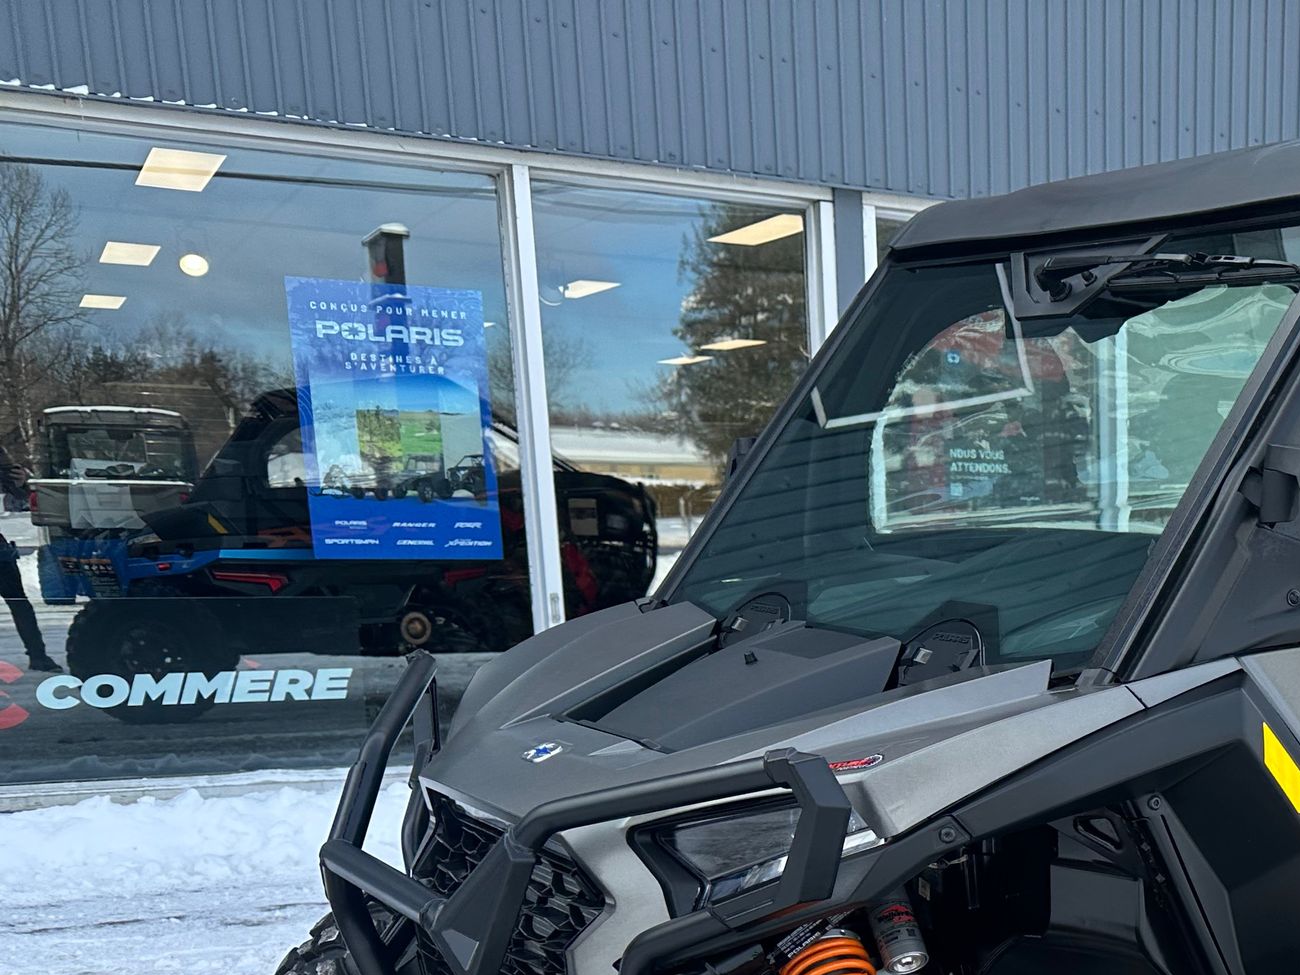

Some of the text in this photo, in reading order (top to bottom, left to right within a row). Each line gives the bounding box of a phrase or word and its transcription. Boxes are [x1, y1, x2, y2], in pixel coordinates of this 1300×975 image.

[309, 301, 467, 320] CONÇUS POUR MENER
[315, 320, 465, 347] POLARIS
[344, 361, 446, 375] S'AVENTURER
[949, 448, 1005, 460] NOUS VOUS
